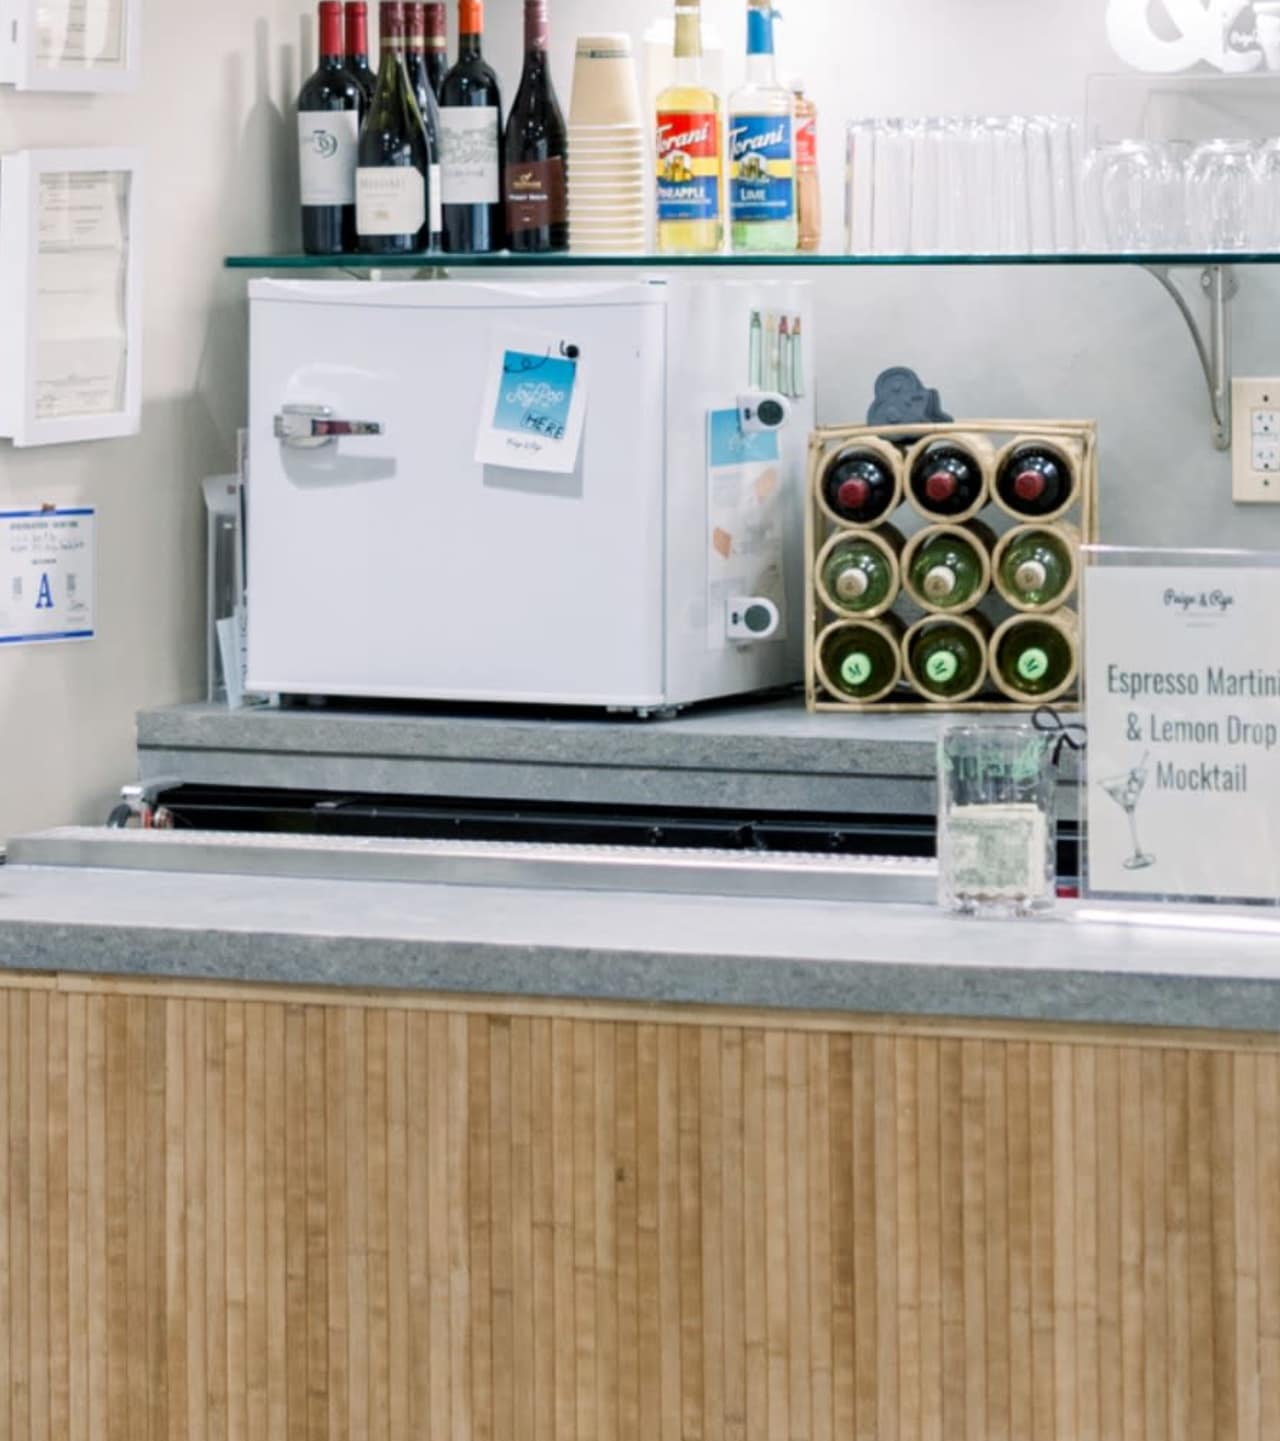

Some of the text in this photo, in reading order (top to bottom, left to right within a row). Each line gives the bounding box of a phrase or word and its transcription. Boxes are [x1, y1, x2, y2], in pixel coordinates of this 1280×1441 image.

[729, 124, 784, 159] Torani
[35, 572, 54, 608] A
[1163, 588, 1196, 610] Paige
[1209, 589, 1234, 611] Rye
[1107, 664, 1199, 700] Espresso
[1126, 712, 1278, 750] & Lemon Drop
[1157, 761, 1247, 793] Mocktail
